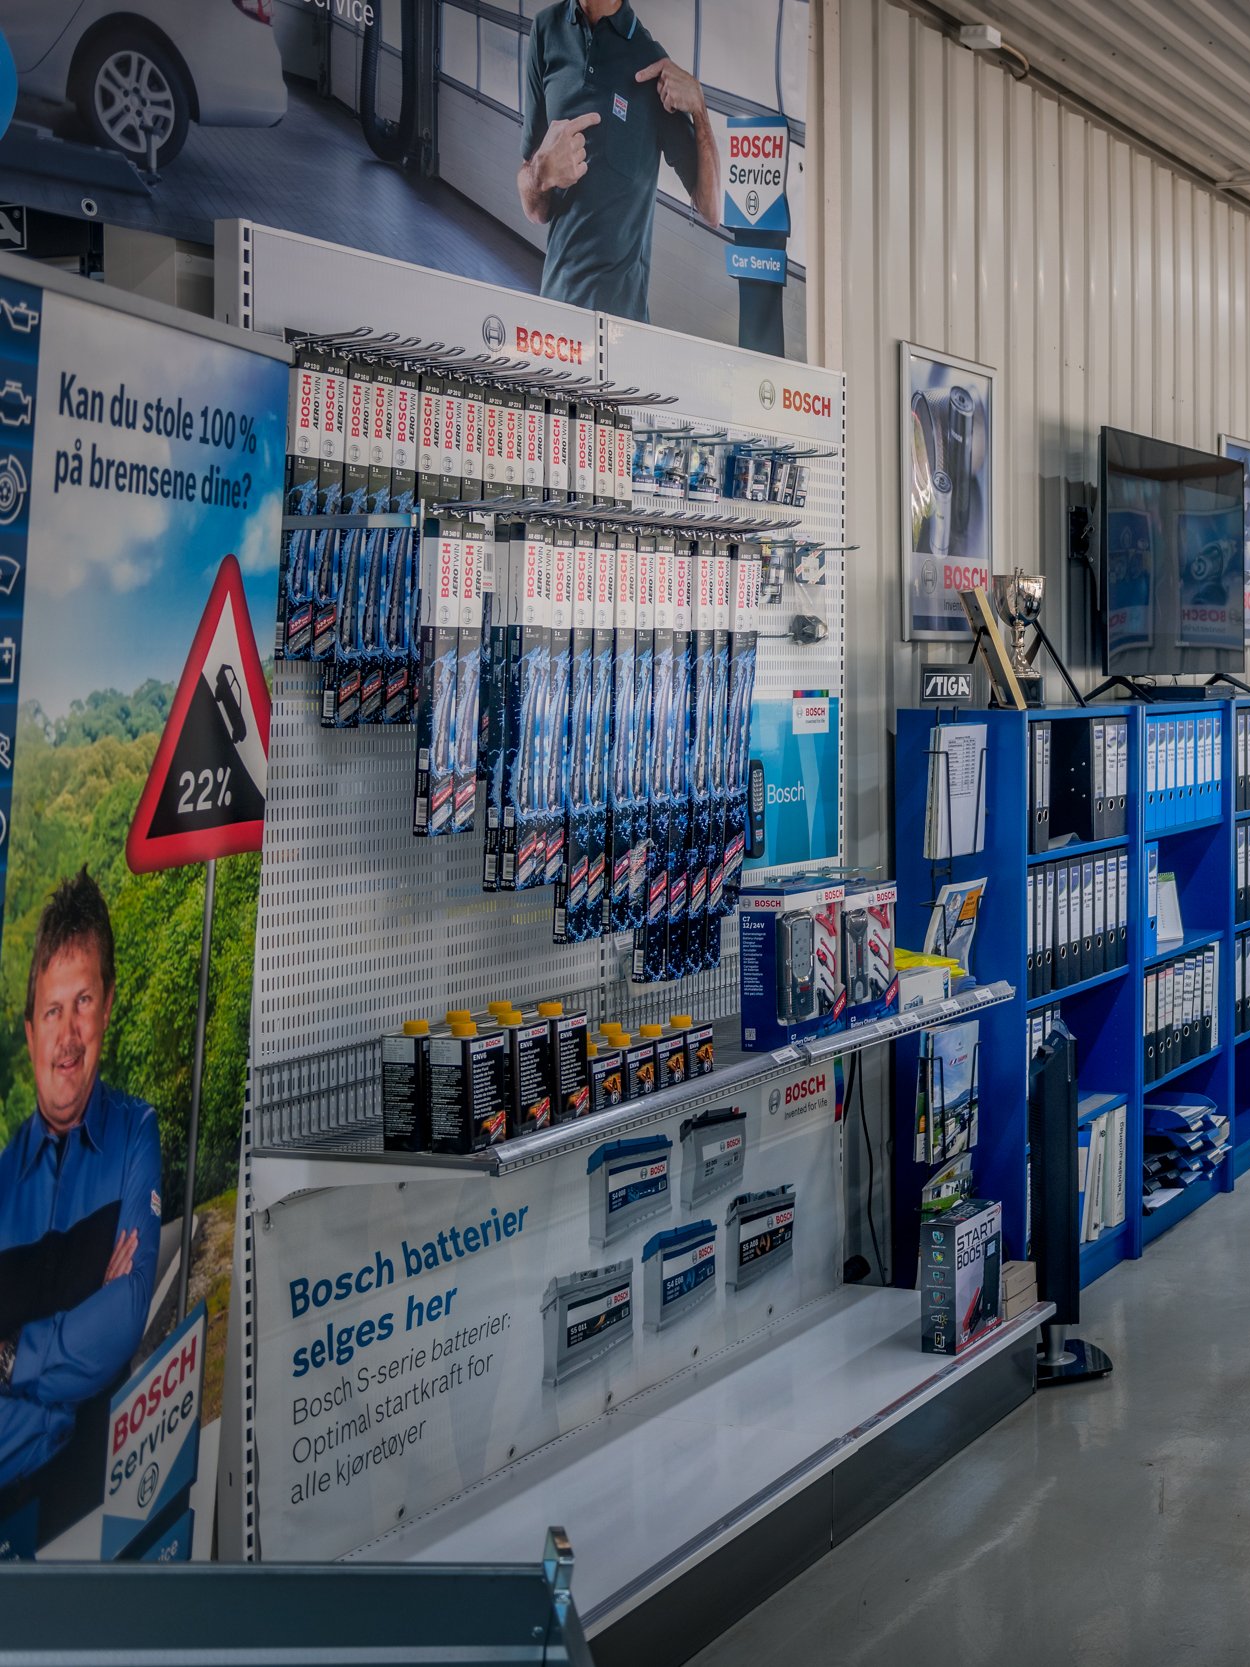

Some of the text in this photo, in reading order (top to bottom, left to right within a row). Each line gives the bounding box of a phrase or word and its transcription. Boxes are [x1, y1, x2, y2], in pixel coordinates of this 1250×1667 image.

[730, 135, 784, 159] BOSCH
[729, 164, 781, 186] Service
[732, 254, 781, 272] Car Service
[516, 326, 583, 365] BOSCH
[58, 371, 257, 454] Kan du stole 100 %
[300, 374, 312, 428] BOSCH
[312, 376, 321, 430] AEROTWIN
[325, 379, 336, 432] BOSCH
[336, 380, 345, 433] AEROTWIN
[351, 384, 362, 438] BOSCH
[362, 386, 371, 439] AEROTWIN
[374, 387, 385, 439] BOSCH
[385, 388, 394, 440] AEROTWIN
[397, 391, 408, 442] BOSCH
[423, 396, 433, 447] BOSCH
[433, 398, 441, 448] AEROTWIN
[445, 400, 454, 449] BOSCH
[782, 388, 831, 417] BOSCH
[454, 401, 462, 451] AEROTWIN
[466, 403, 475, 453] BOSCH
[487, 408, 496, 457] BOSCH
[506, 412, 515, 460] BOSCH
[528, 414, 536, 461] BOSCH
[552, 418, 561, 465] BOSCH
[54, 438, 252, 510] på bremsene dine?
[599, 428, 607, 473] BOSCH
[617, 432, 625, 478] BOSCH
[441, 543, 451, 598] BOSCH
[464, 545, 474, 599] BOSCH
[527, 545, 536, 598] BOSCH
[556, 551, 565, 602] BOSCH
[577, 551, 586, 602] BOSCH
[598, 553, 607, 603] BOSCH
[620, 553, 628, 603] BOSCH
[658, 556, 666, 604] BOSCH
[677, 560, 685, 607] BOSCH
[944, 565, 988, 593] BOSCH
[925, 674, 970, 696] STIGA
[805, 707, 826, 717] BOSCH
[177, 766, 232, 815] 22%
[767, 781, 805, 804] Bosch
[754, 900, 781, 908] BOSCH
[825, 889, 843, 900] BOSCH
[876, 890, 896, 903] BOSCH
[485, 1039, 501, 1048] BOSCH
[520, 1040, 533, 1049] ENV6
[531, 1027, 545, 1036] BOSCH
[560, 1030, 573, 1040] ENV6
[571, 1018, 585, 1027] BOSCH
[473, 1052, 487, 1061] ENV6
[606, 1059, 619, 1068] BOSCH
[784, 1097, 828, 1120] Invented for life
[785, 1074, 826, 1104] BOSCH
[726, 1136, 741, 1149] BOSCH
[650, 1164, 665, 1176] BOSCH
[775, 1212, 793, 1224] BOSCH
[957, 1217, 995, 1253] START
[288, 1205, 529, 1319] Bosch batterier
[698, 1245, 713, 1259] BOSCH
[957, 1242, 986, 1271] BOOST
[613, 1290, 629, 1304] BOSCH
[667, 1280, 674, 1290] S4
[292, 1287, 458, 1378] selges her
[577, 1323, 587, 1332] 011
[293, 1312, 511, 1425] Bosch S-serie batterier:
[112, 1335, 197, 1456] BOSCH
[292, 1352, 493, 1464] Optimal startkraft for
[109, 1390, 194, 1496] Service
[291, 1418, 427, 1504] alle kjøretøyer
